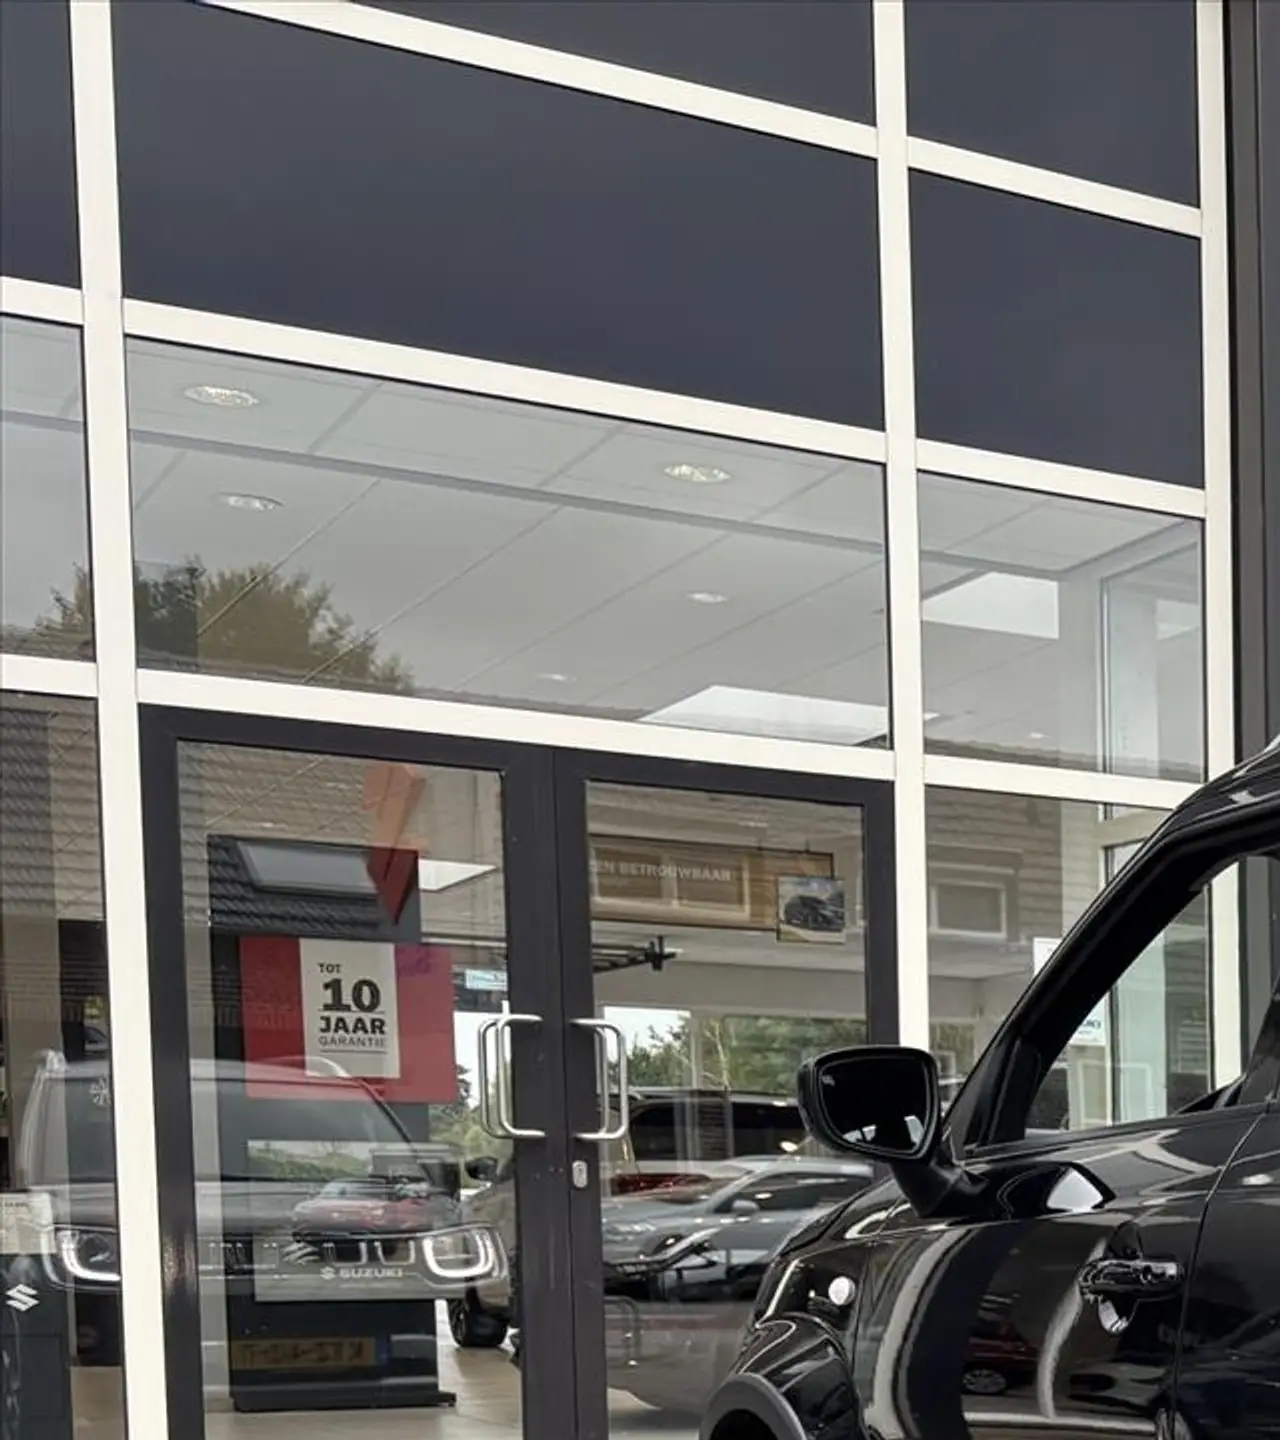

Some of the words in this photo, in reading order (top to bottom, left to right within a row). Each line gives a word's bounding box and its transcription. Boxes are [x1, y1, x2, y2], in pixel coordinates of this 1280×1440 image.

[317, 962, 342, 974] TOT
[322, 977, 381, 1013] 10
[319, 1015, 385, 1035] JAAR
[318, 1035, 386, 1048] GARANTIE
